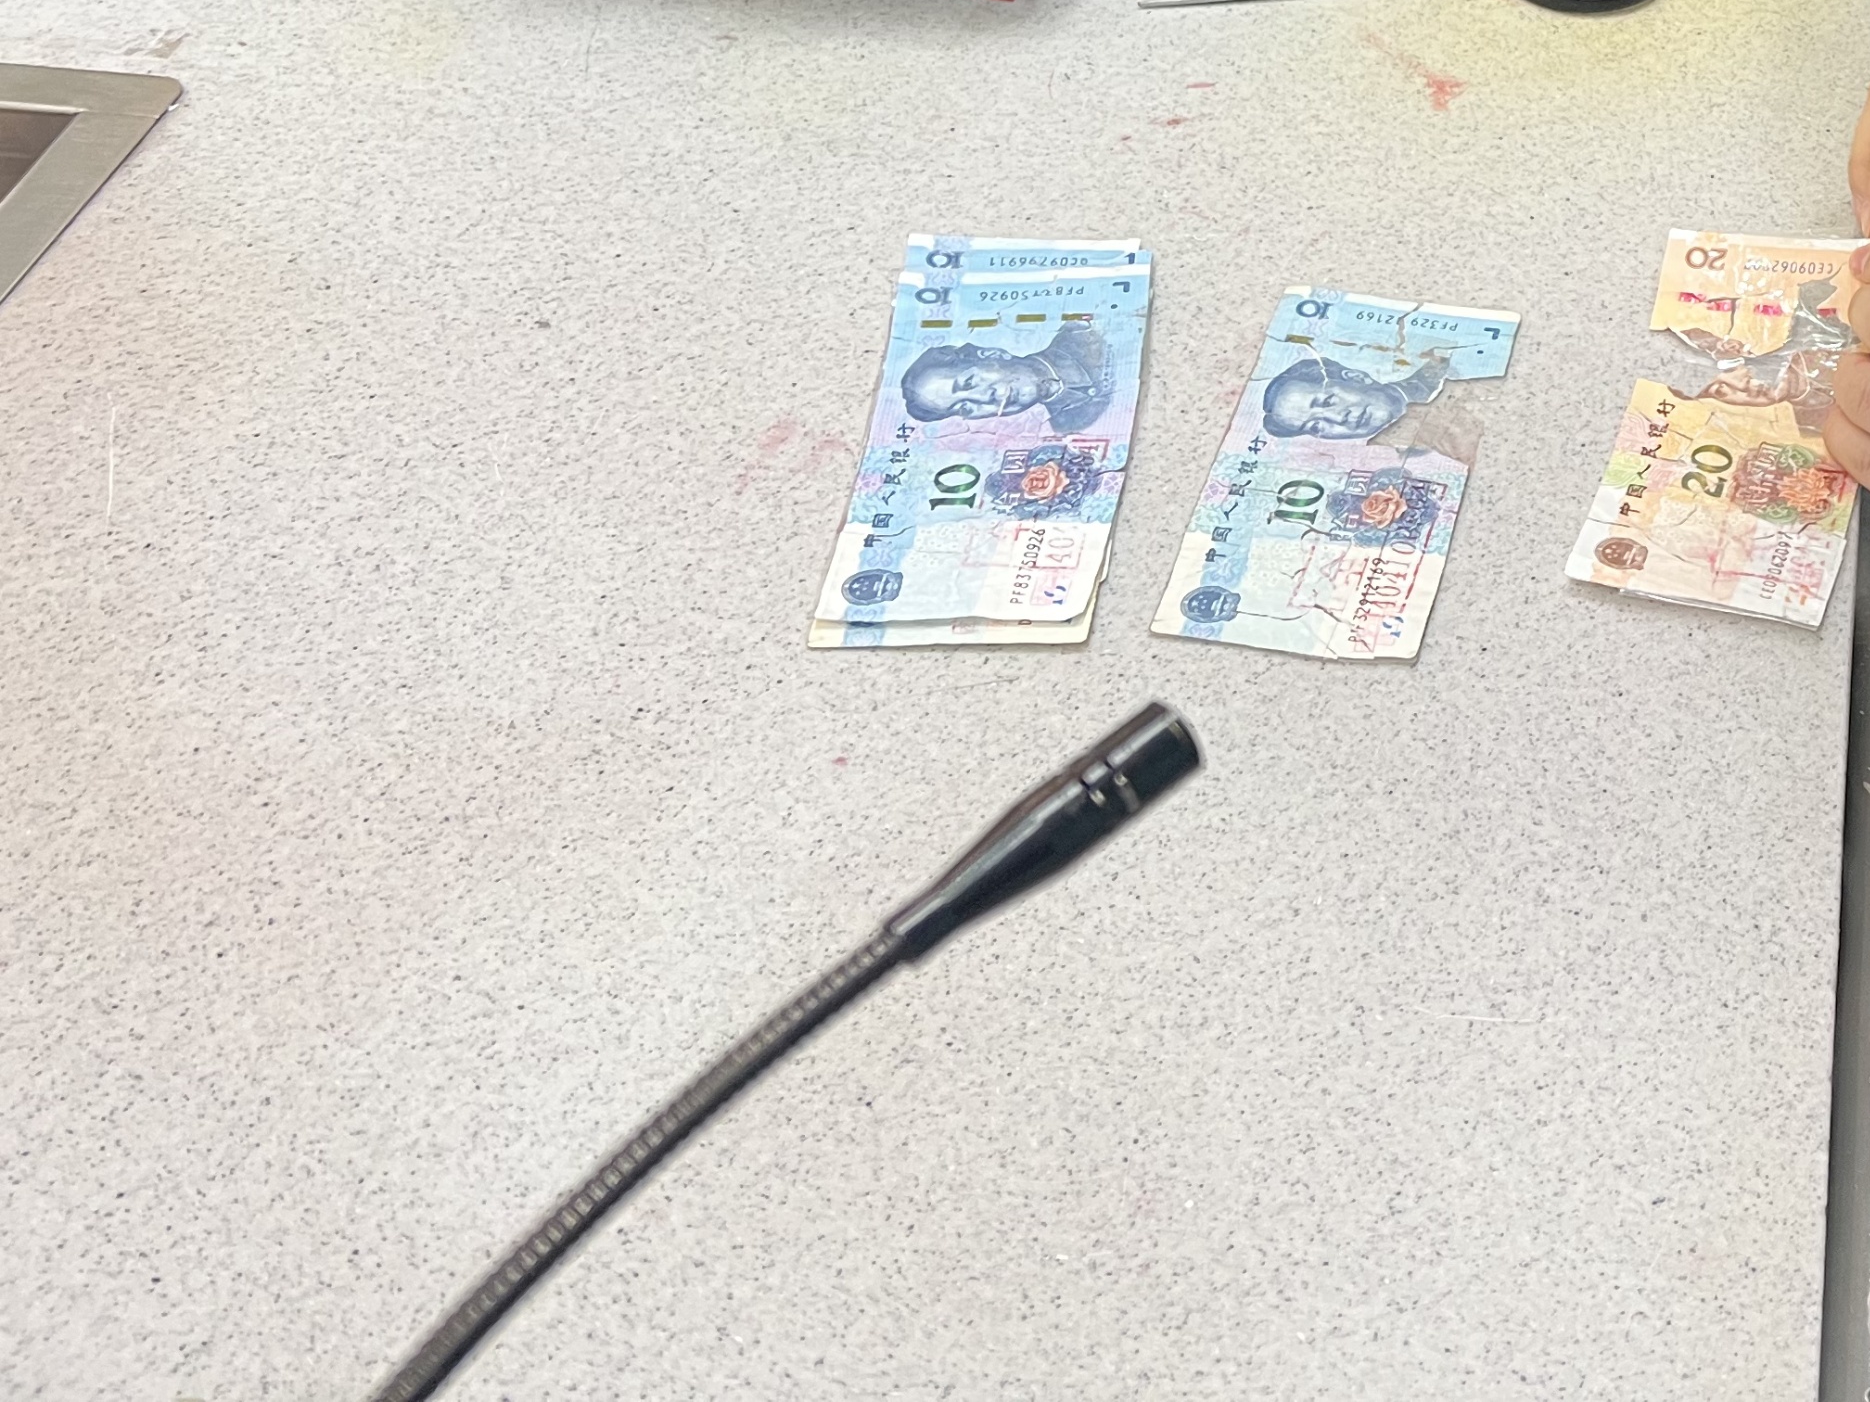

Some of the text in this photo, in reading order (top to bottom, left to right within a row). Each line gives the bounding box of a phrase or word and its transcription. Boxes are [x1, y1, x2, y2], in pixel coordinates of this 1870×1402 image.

[925, 250, 963, 269] 10
[1685, 247, 1728, 271] 20
[915, 286, 954, 306] 10
[1295, 299, 1334, 320] 10
[1620, 399, 1676, 517] 中国人民银行
[1681, 444, 1733, 498] 20
[864, 422, 915, 547] 中国人民银行
[929, 464, 981, 511] 10
[1205, 436, 1268, 563] 中国人民银行
[1267, 479, 1325, 525] 10
